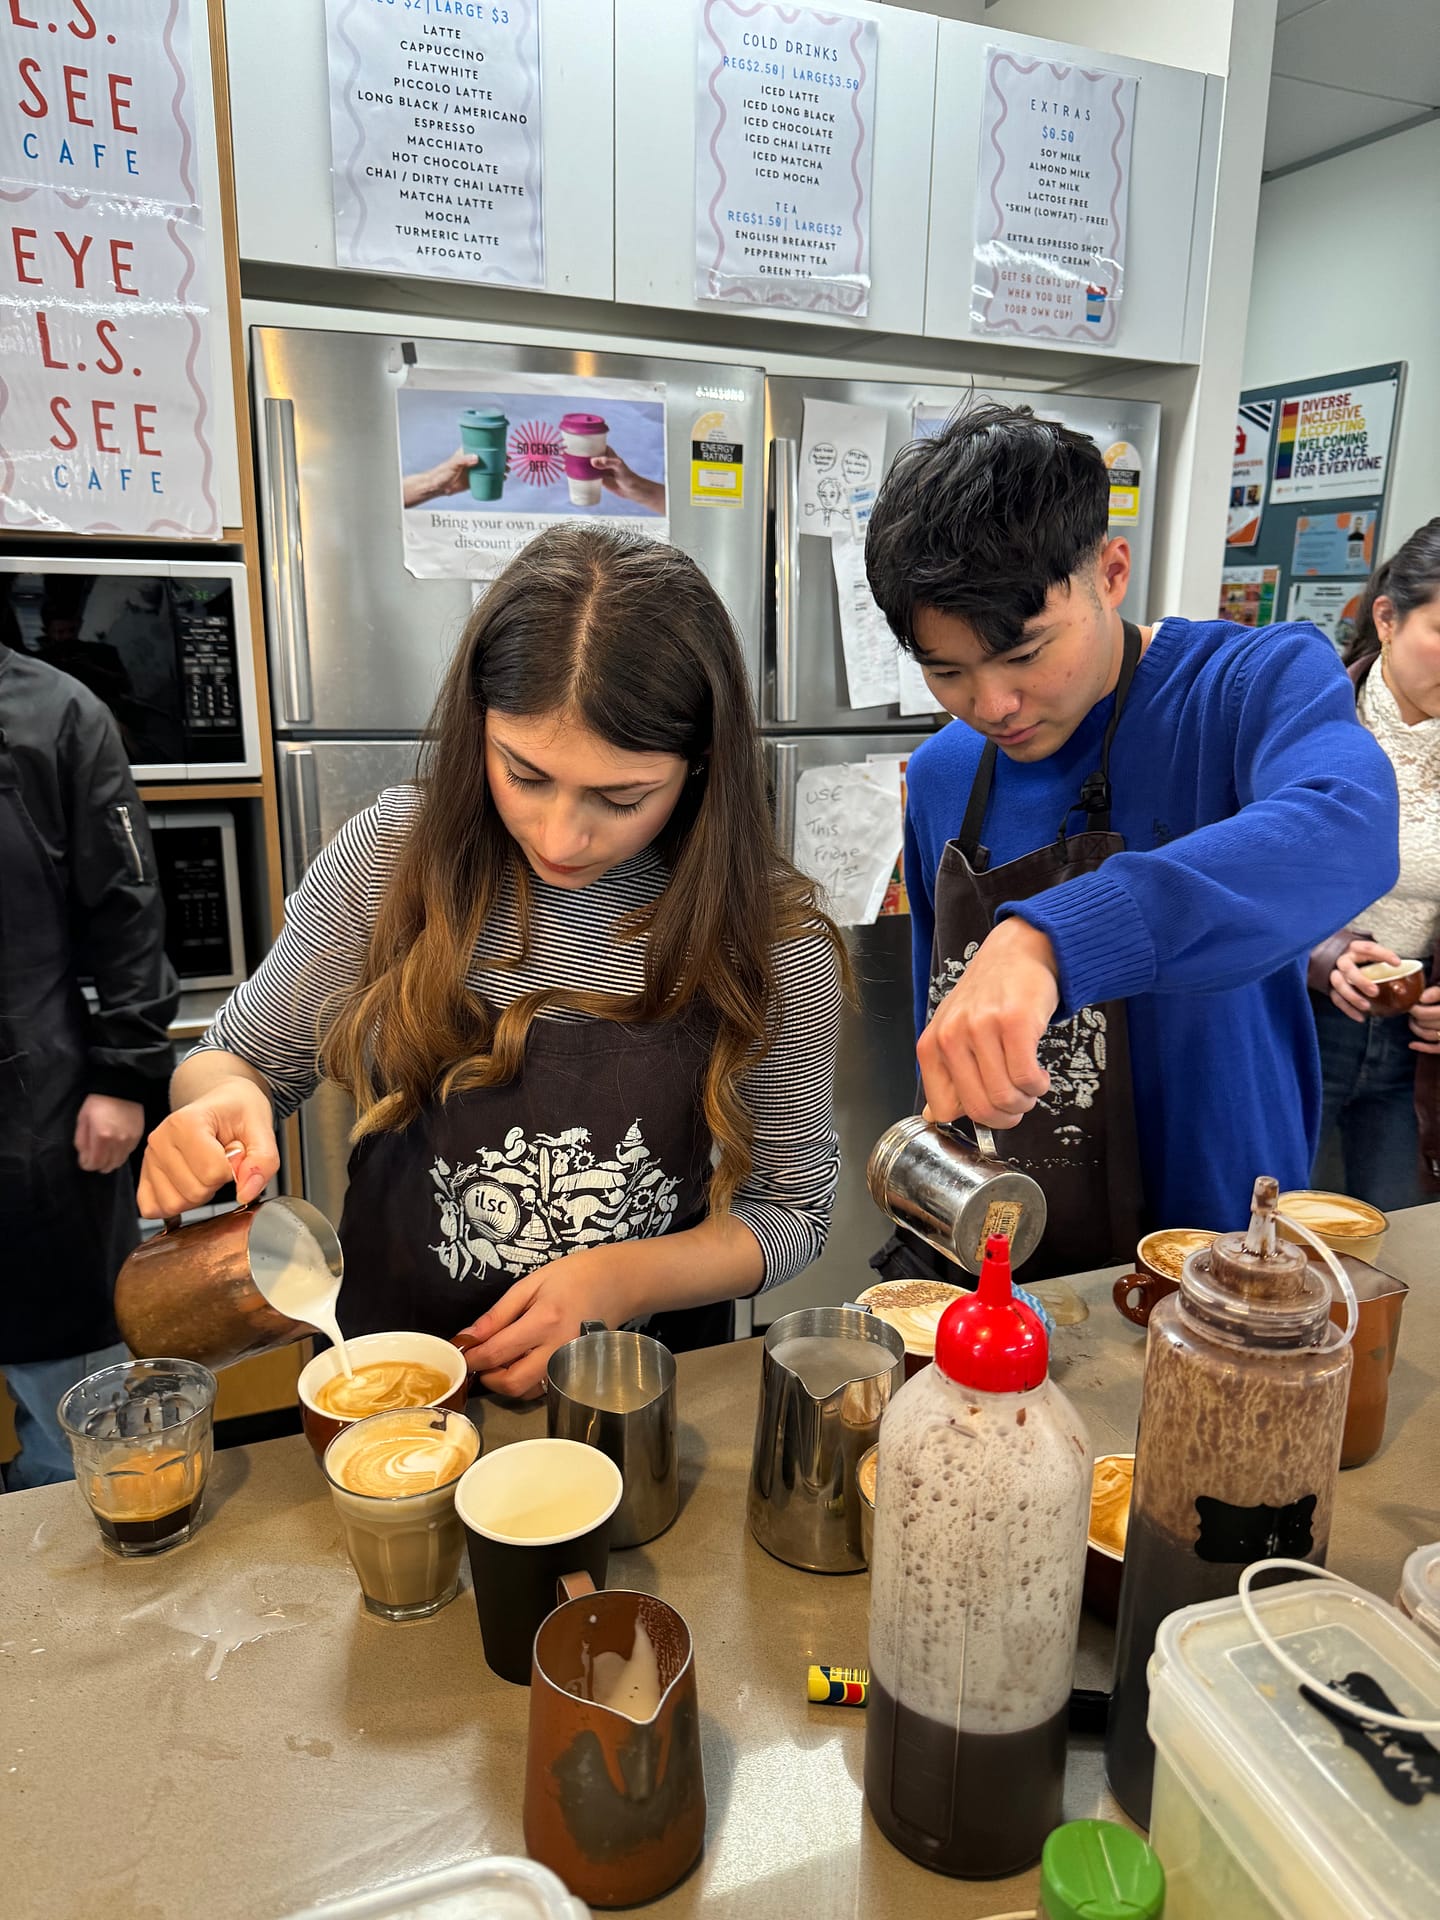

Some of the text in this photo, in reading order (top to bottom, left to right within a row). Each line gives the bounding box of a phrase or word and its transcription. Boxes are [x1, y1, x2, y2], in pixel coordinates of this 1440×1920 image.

[491, 8, 510, 24] $3
[423, 25, 461, 39] LATTE
[399, 40, 485, 62] CAPPUCCINO
[743, 32, 838, 62] COLD DRINKS
[407, 60, 480, 80] FLATWHITE
[793, 67, 860, 91] LARGE$3.50
[18, 57, 139, 135] SEE
[393, 77, 493, 101] PICCOLO LATTE
[761, 85, 819, 104] ICED LATTE
[357, 90, 528, 125] LONG BLACK / AMERICANO
[743, 99, 836, 123] ICED LONG BLACK
[1031, 99, 1091, 121] EXTRAS
[414, 118, 476, 135] ESPRESSO
[744, 116, 833, 139] ICED CHOCOLATE
[1042, 125, 1075, 143] $0.50
[407, 135, 484, 154] MACCHIATO
[745, 132, 831, 155] ICED CHAI LATTE
[23, 133, 140, 176] CAFE
[392, 152, 499, 175] HOT CHOCOLATE
[753, 151, 823, 170] ICED MATCHA
[1040, 148, 1081, 162] SOY MILK
[755, 168, 820, 186] ICED MOCHA
[1029, 162, 1090, 179] ALMOND MILK
[365, 166, 525, 196] CHAI / DIRTY CHAI LATTE
[1038, 178, 1080, 192] OAT MILK
[399, 190, 494, 210] MATCHA LATTE
[775, 201, 797, 215] TEA
[1028, 192, 1089, 208] LACTOSE FREE
[425, 211, 471, 225] MOCHA
[1034, 207, 1077, 223] (LOWFAT)
[1086, 215, 1109, 226] FREE!
[395, 225, 500, 246] TURMERIC LATTE
[795, 219, 843, 236] LARGE$2
[735, 230, 837, 252] ENGLISH BREAKFAST
[1007, 233, 1104, 254] EXTRA ESPRESSO SHOT
[11, 226, 140, 298] EYE
[416, 246, 482, 261] AFFOGATO
[744, 247, 828, 265] PEPPERMINT TEA
[1062, 256, 1090, 267] CREAM
[759, 265, 791, 276] GREEN
[1001, 271, 1017, 281] GET
[1021, 273, 1032, 284] 50
[1035, 275, 1061, 287] CENTS
[1008, 288, 1072, 305] WHEN YOU USE
[1005, 304, 1027, 315] YOUR
[1031, 307, 1050, 317] OWN
[36, 312, 142, 377] L.S.
[1302, 393, 1352, 413] DIVERSE
[1301, 405, 1363, 425] INCLUSIVE
[49, 396, 163, 458] SEE
[1300, 418, 1366, 438] ACCEPTING
[517, 442, 559, 456] 50 CENTS
[700, 443, 735, 454] ENERGY
[1298, 432, 1368, 451] WELCOMING
[702, 451, 733, 463] RATING
[1296, 445, 1369, 465] SAFE SPACE
[1294, 456, 1383, 478] FOR EVERYONE
[54, 465, 165, 494] CAFE
[431, 514, 469, 530] Bring
[473, 518, 504, 532] your
[506, 521, 536, 531] own
[454, 534, 511, 550] discount
[806, 785, 843, 804] USE
[474, 1189, 507, 1215] ilsc
